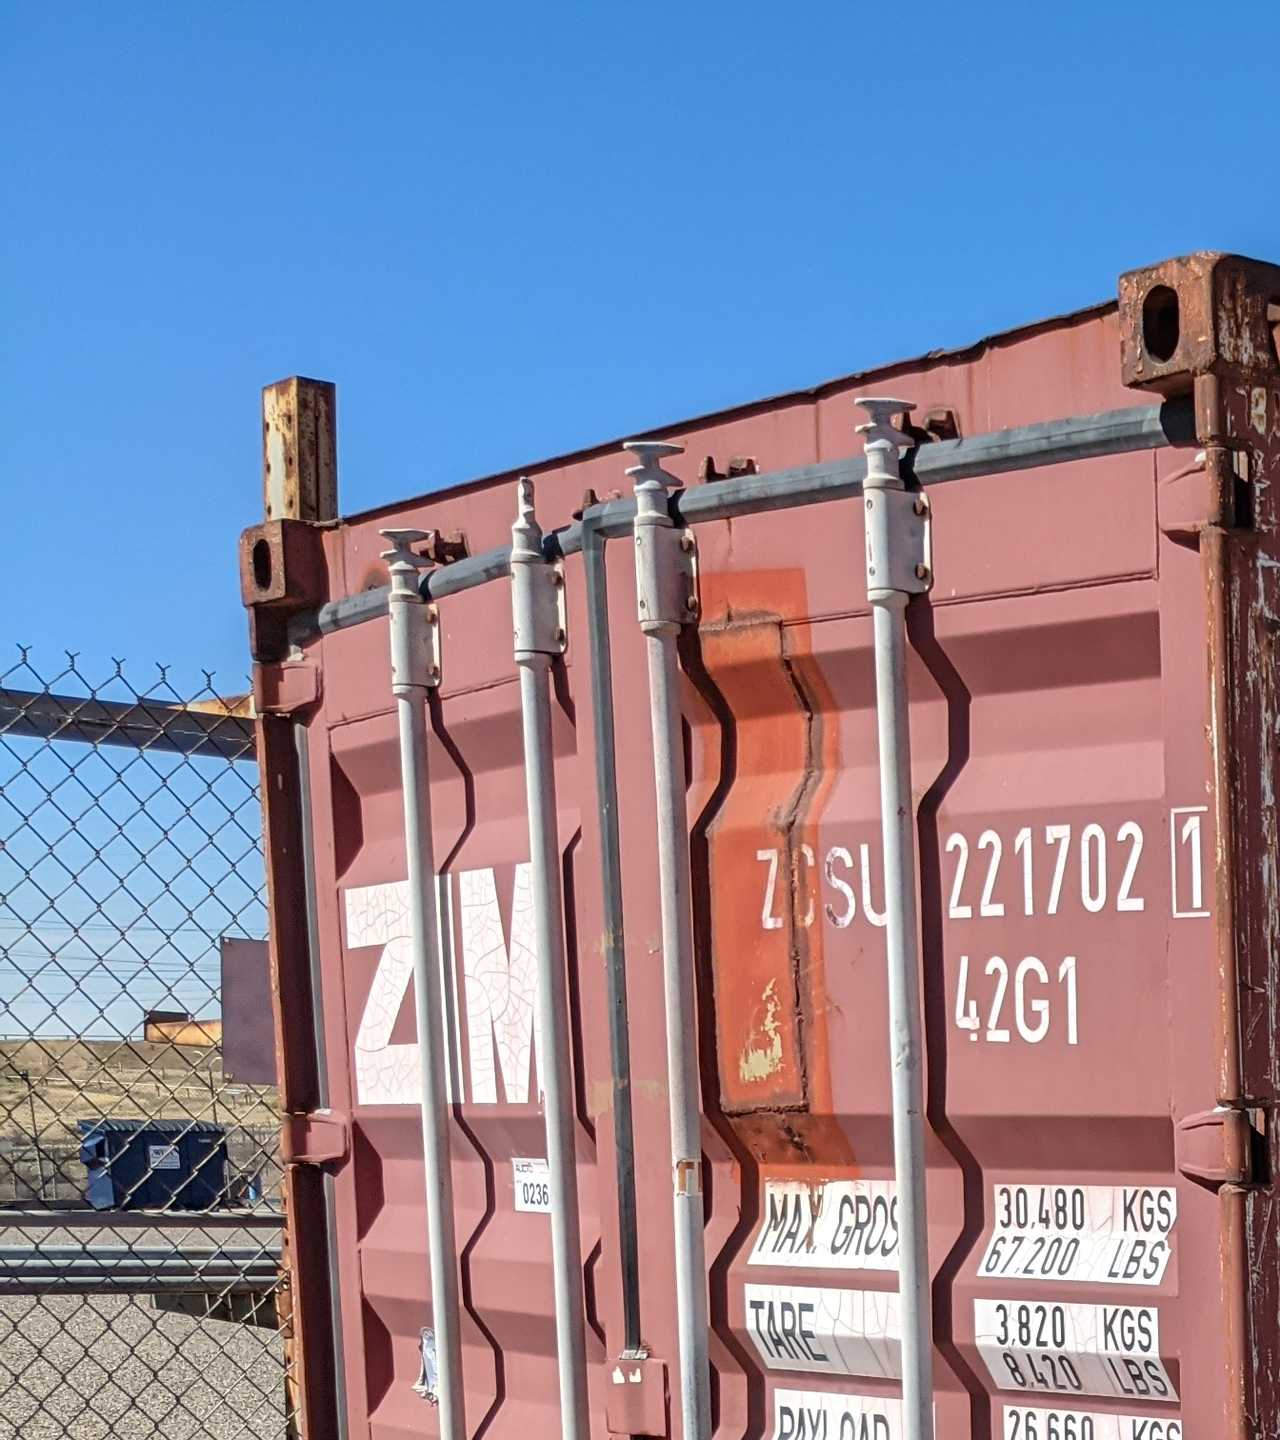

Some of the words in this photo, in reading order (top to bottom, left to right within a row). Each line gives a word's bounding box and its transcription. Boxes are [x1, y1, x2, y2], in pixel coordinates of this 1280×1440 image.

[945, 821, 1145, 919] 221702
[955, 954, 1079, 1046] 42G1
[523, 1182, 549, 1206] 0236
[1123, 1188, 1173, 1233] KGS
[830, 1194, 900, 1258] GROS
[1107, 1237, 1169, 1281] LBS
[750, 1300, 829, 1362] TARE
[1103, 1307, 1153, 1353] KGS
[1106, 1358, 1169, 1397] LBS
